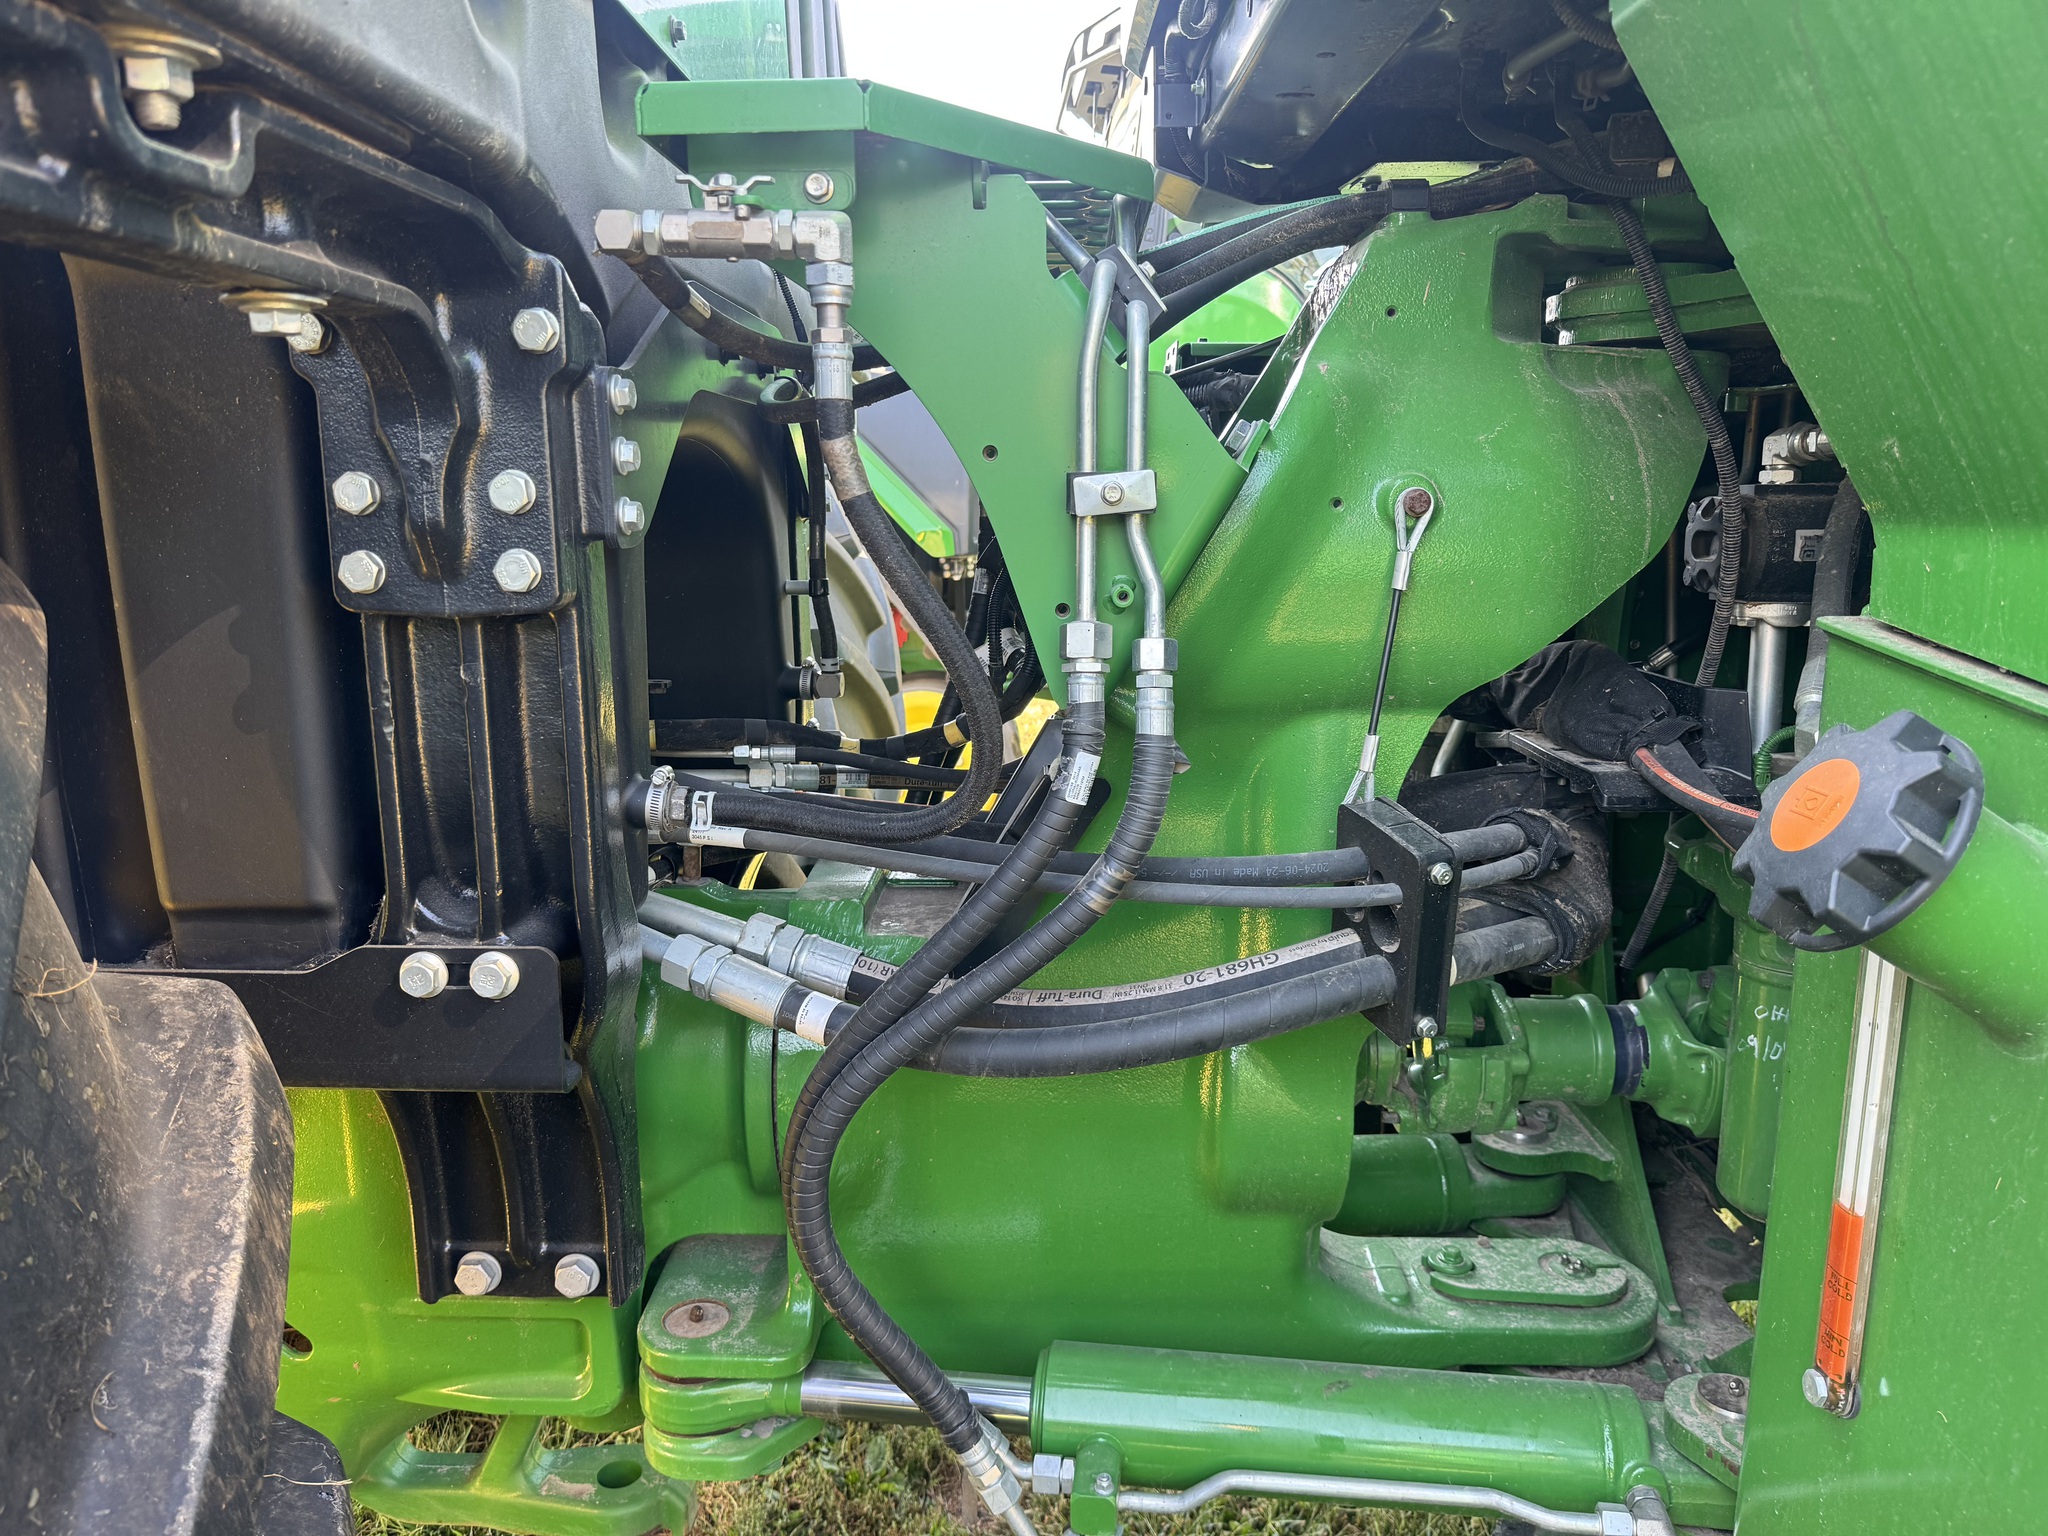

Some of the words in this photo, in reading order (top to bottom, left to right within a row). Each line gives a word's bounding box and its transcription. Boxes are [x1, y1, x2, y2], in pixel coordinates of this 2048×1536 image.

[1189, 868, 1209, 878] USA
[1213, 868, 1226, 878] in
[1233, 867, 1259, 877] Made
[1265, 862, 1329, 876] 2024-06-24
[1288, 941, 1317, 953] Danfoss
[1183, 952, 1279, 986] GH681-20
[1035, 989, 1103, 1003] Dura-Tuff
[1830, 1271, 1851, 1292] FULL
[1827, 1280, 1853, 1302] COLD
[1824, 1327, 1843, 1347] MIN
[1821, 1335, 1846, 1358] COLD
